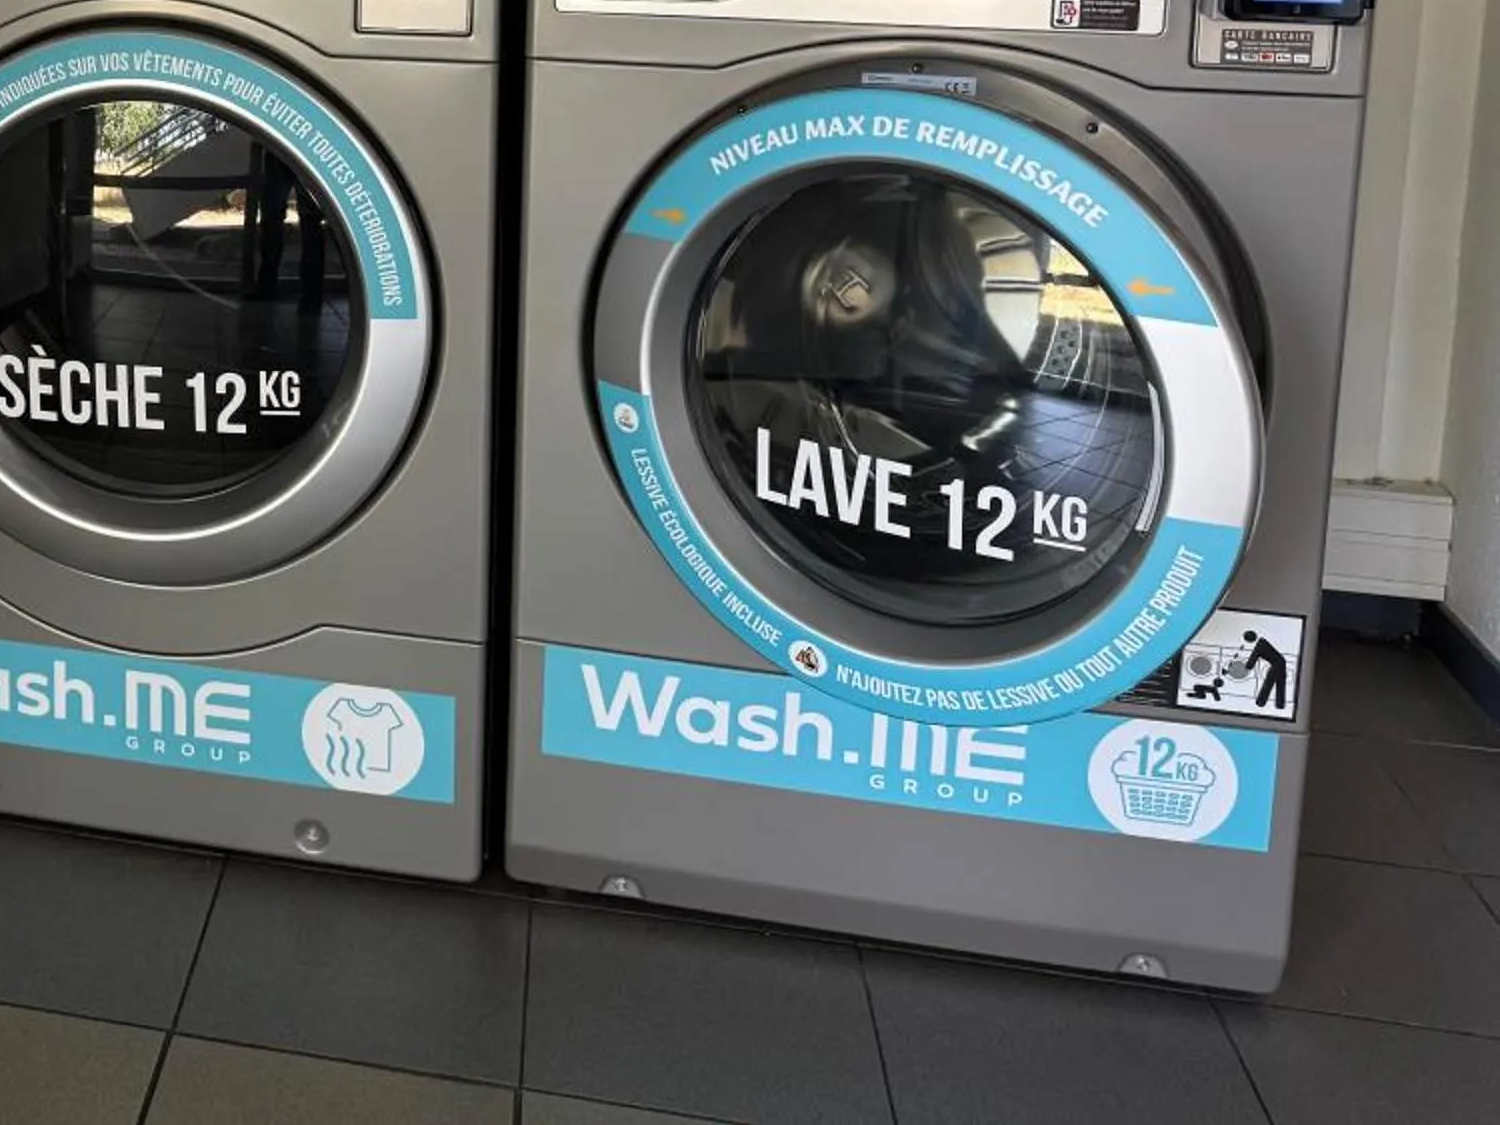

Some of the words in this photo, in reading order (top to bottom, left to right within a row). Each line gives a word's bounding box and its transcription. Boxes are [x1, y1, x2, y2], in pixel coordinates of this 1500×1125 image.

[67, 55, 97, 78] SUR
[100, 51, 129, 72] VOS
[133, 49, 224, 87] VÊTEMENTS
[223, 72, 265, 107] POUR
[260, 91, 313, 141] ÉVITER
[307, 129, 355, 186] TOUTES
[709, 122, 799, 176] NIVEAU
[804, 114, 866, 140] MAX
[872, 115, 911, 140] DE
[915, 121, 1109, 228] REMPLISSAGE
[185, 372, 247, 434] 12
[259, 370, 301, 410] KG
[630, 446, 668, 510] LESSIVE
[722, 590, 783, 648] INCLUSE
[755, 426, 912, 539] LAVE
[940, 478, 1017, 562] 12
[1033, 490, 1088, 543] KG
[835, 663, 924, 707] N'AJOUTEZ
[925, 688, 961, 712] PAS
[964, 688, 986, 711] DE
[987, 678, 1061, 711] LESSIVE
[1055, 667, 1085, 692] OU
[1082, 645, 1122, 685] TOUT
[1111, 608, 1167, 663] AUTRE
[1149, 544, 1205, 619] PRODUIT
[126, 736, 251, 764] GROUP
[869, 774, 1024, 807] GROUP
[1134, 733, 1176, 780] 12
[1175, 761, 1200, 782] KG
